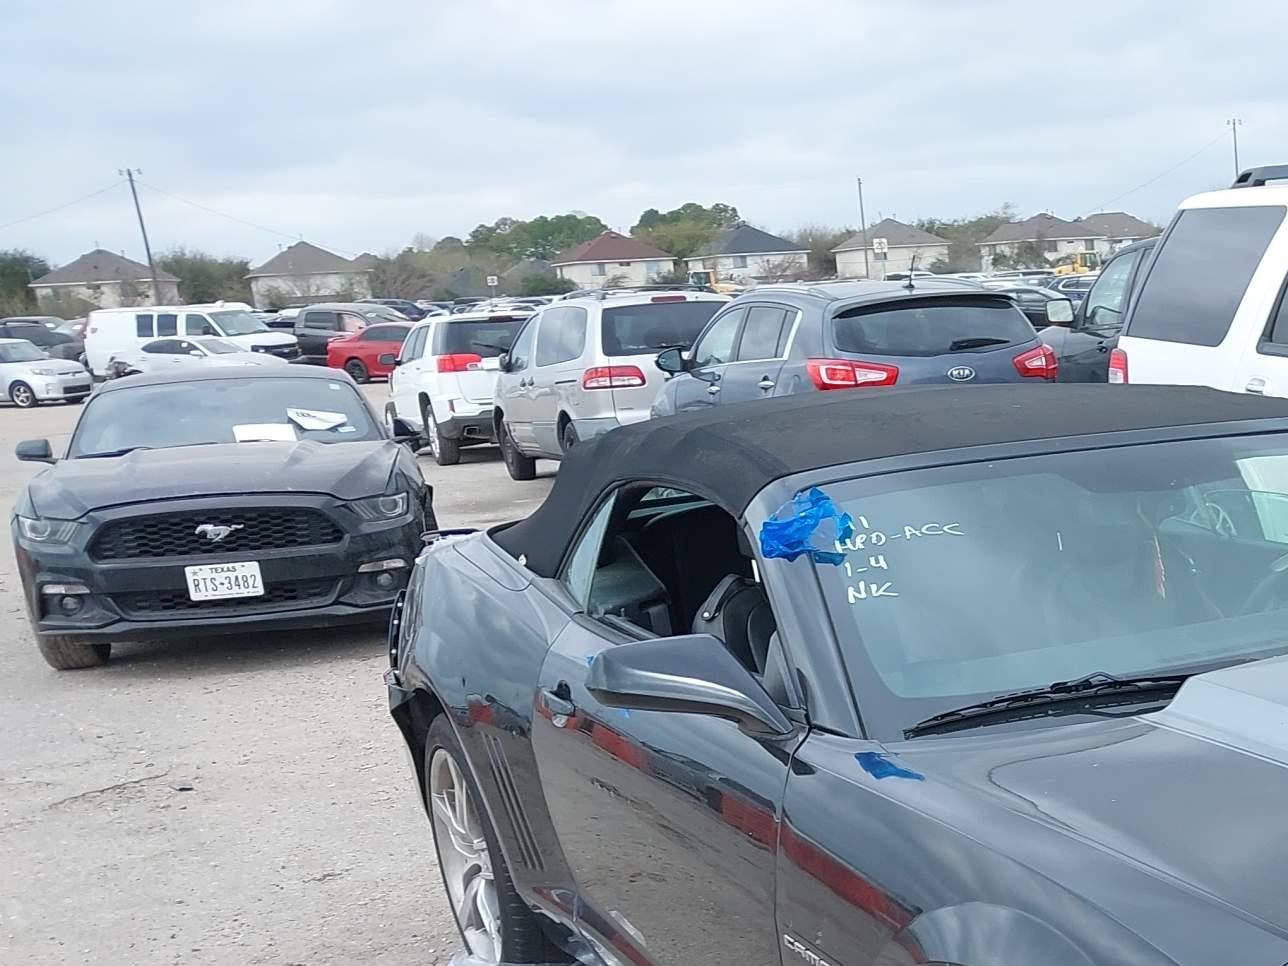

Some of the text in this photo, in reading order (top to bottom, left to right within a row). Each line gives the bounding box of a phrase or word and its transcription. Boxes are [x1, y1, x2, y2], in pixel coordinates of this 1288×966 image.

[952, 369, 971, 378] KIA
[208, 565, 237, 574] TEXAS
[192, 573, 259, 594] RTS-3482
